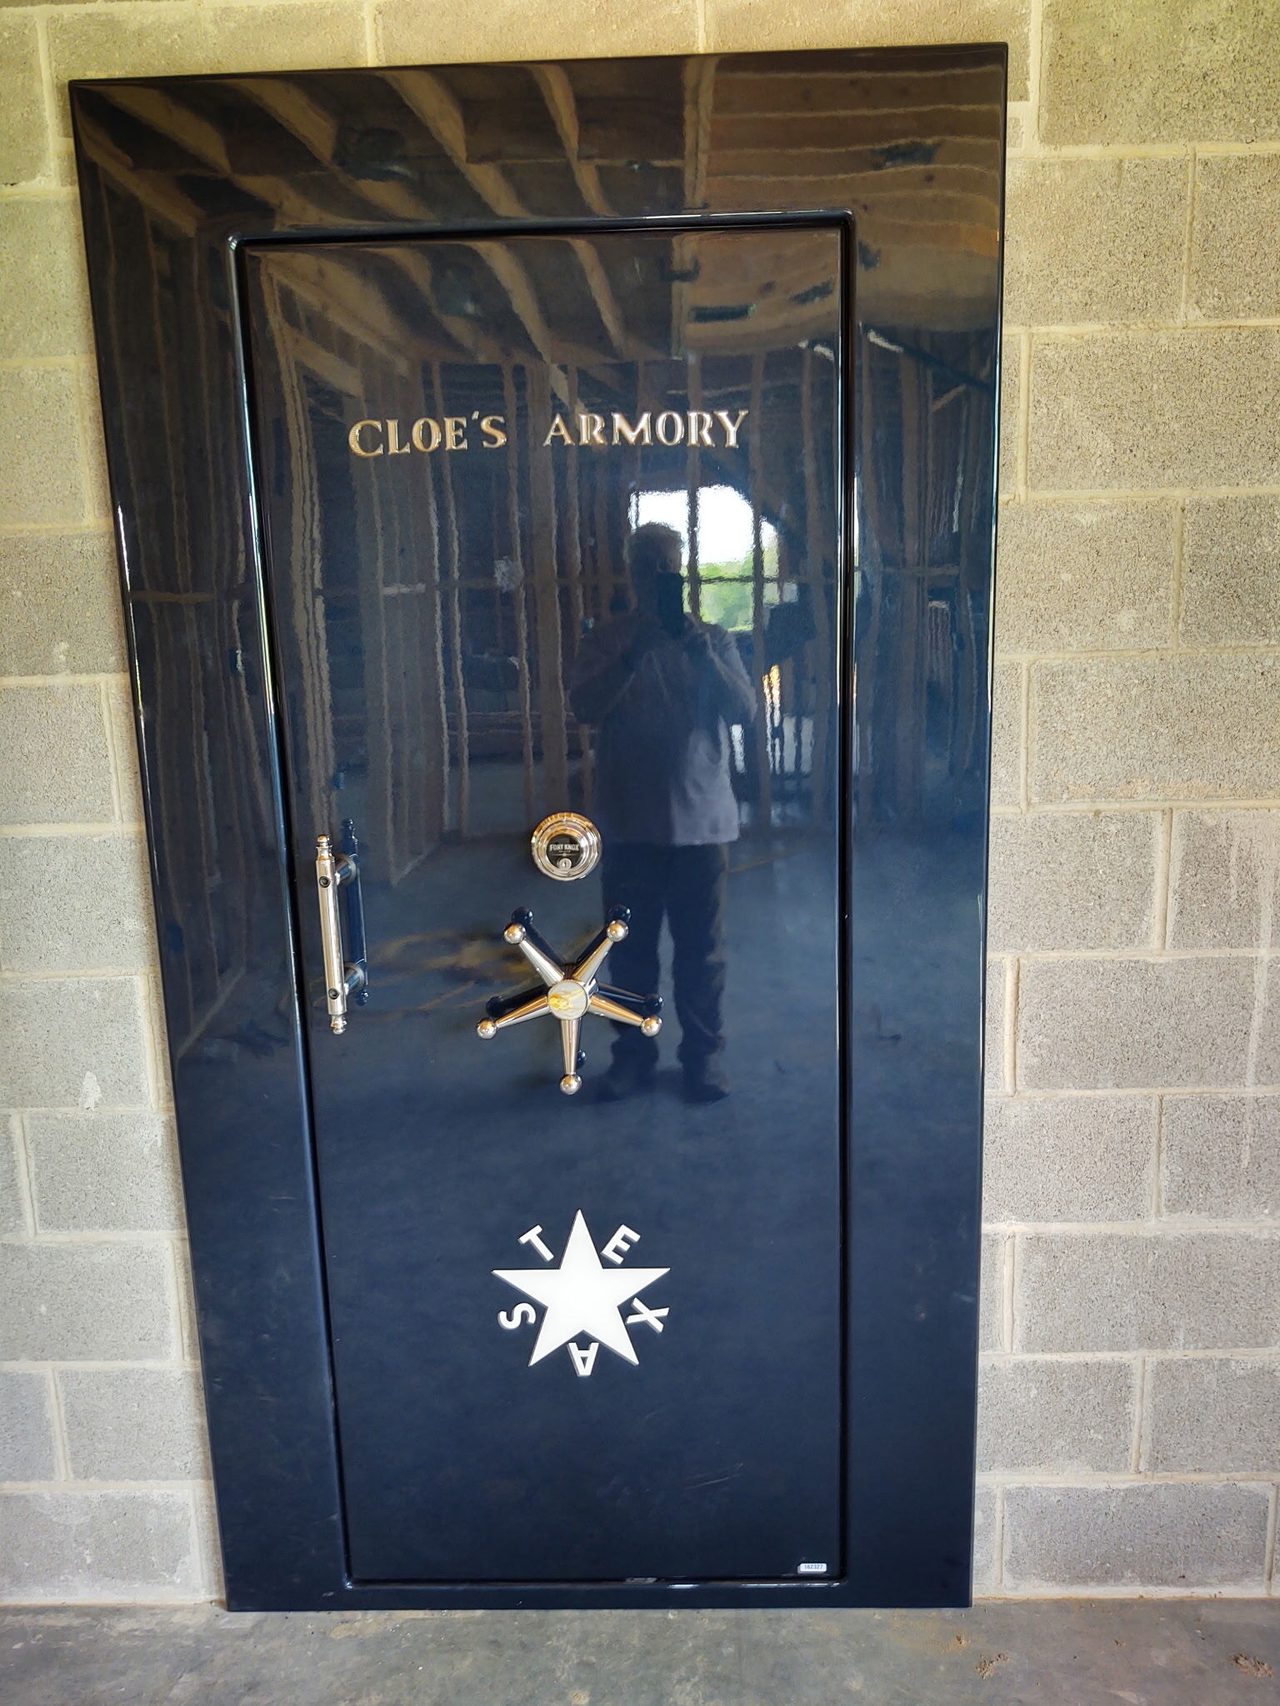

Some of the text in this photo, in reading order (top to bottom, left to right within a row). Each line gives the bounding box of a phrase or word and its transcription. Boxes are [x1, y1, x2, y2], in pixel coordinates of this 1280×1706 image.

[348, 410, 749, 458] CLOE'S ARMORY
[564, 843, 580, 851] KNOX
